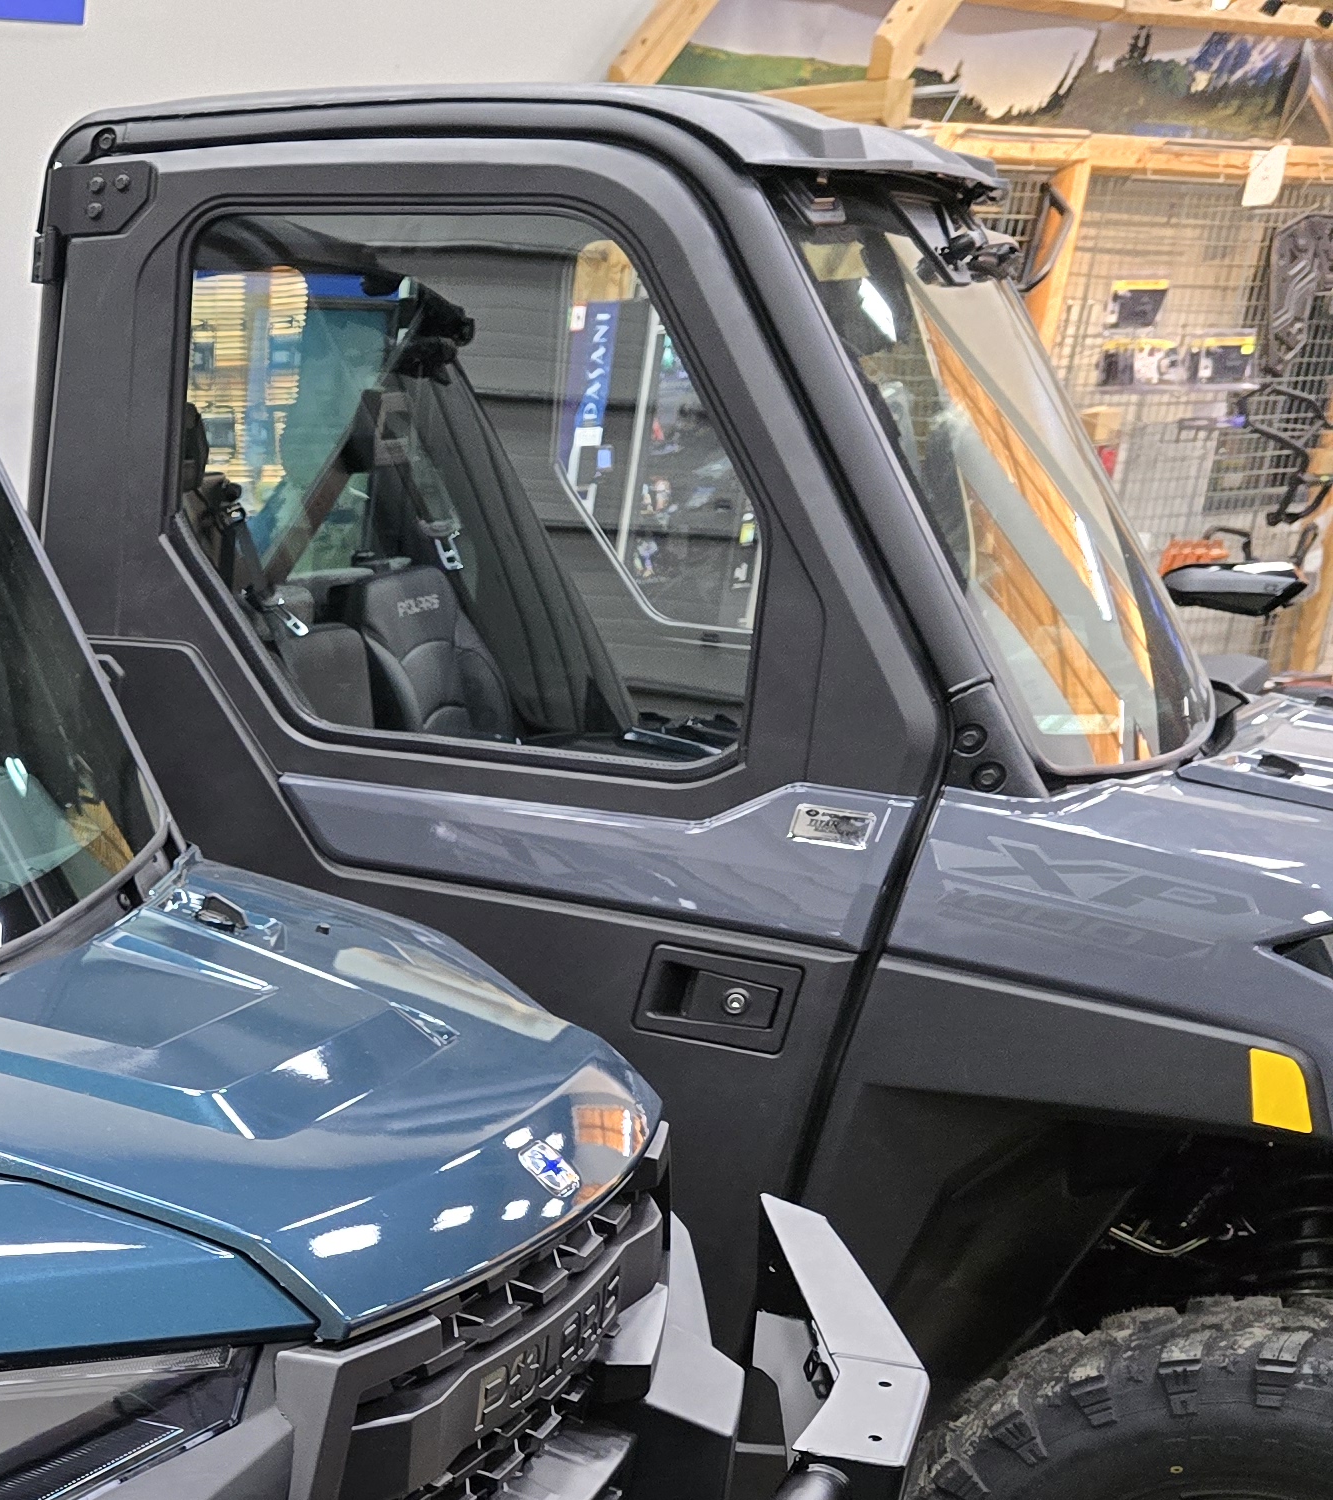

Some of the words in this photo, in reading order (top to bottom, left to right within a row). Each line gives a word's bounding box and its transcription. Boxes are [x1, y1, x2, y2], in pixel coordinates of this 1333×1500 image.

[582, 312, 612, 421] DASANI
[948, 843, 1257, 917] XP
[473, 1266, 621, 1432] POLARIS
